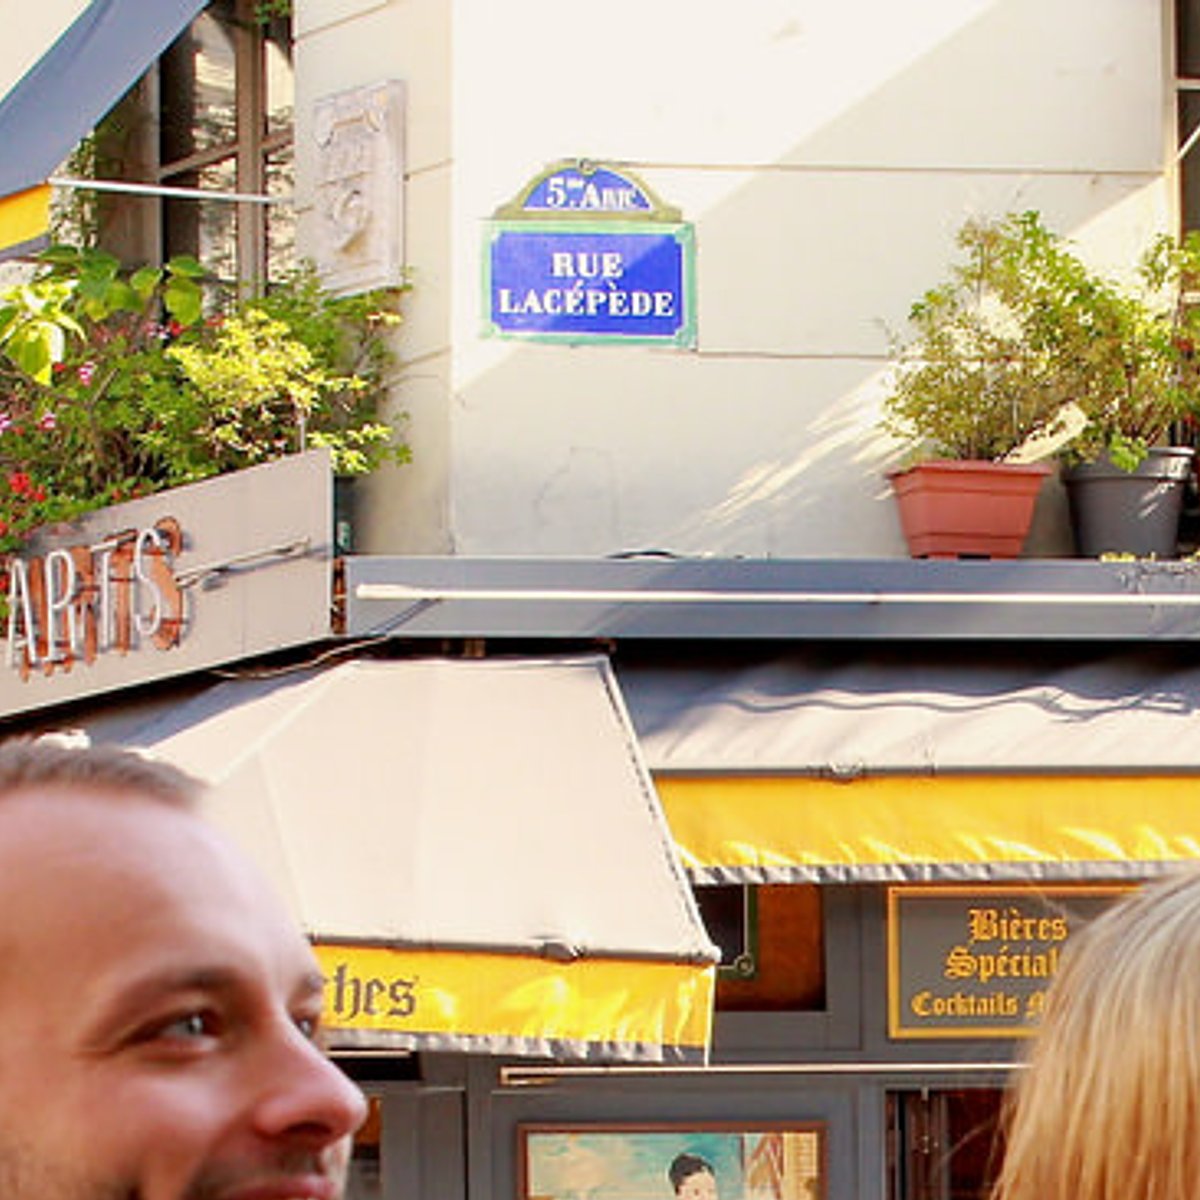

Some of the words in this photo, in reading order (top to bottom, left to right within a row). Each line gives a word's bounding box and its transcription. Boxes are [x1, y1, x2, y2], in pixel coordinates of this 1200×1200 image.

[552, 252, 624, 278] RUE
[499, 279, 675, 317] LACÉPÈDE
[5, 515, 183, 682] ARTS
[968, 907, 1068, 944] Bières
[911, 990, 1019, 1017] Cocktails
